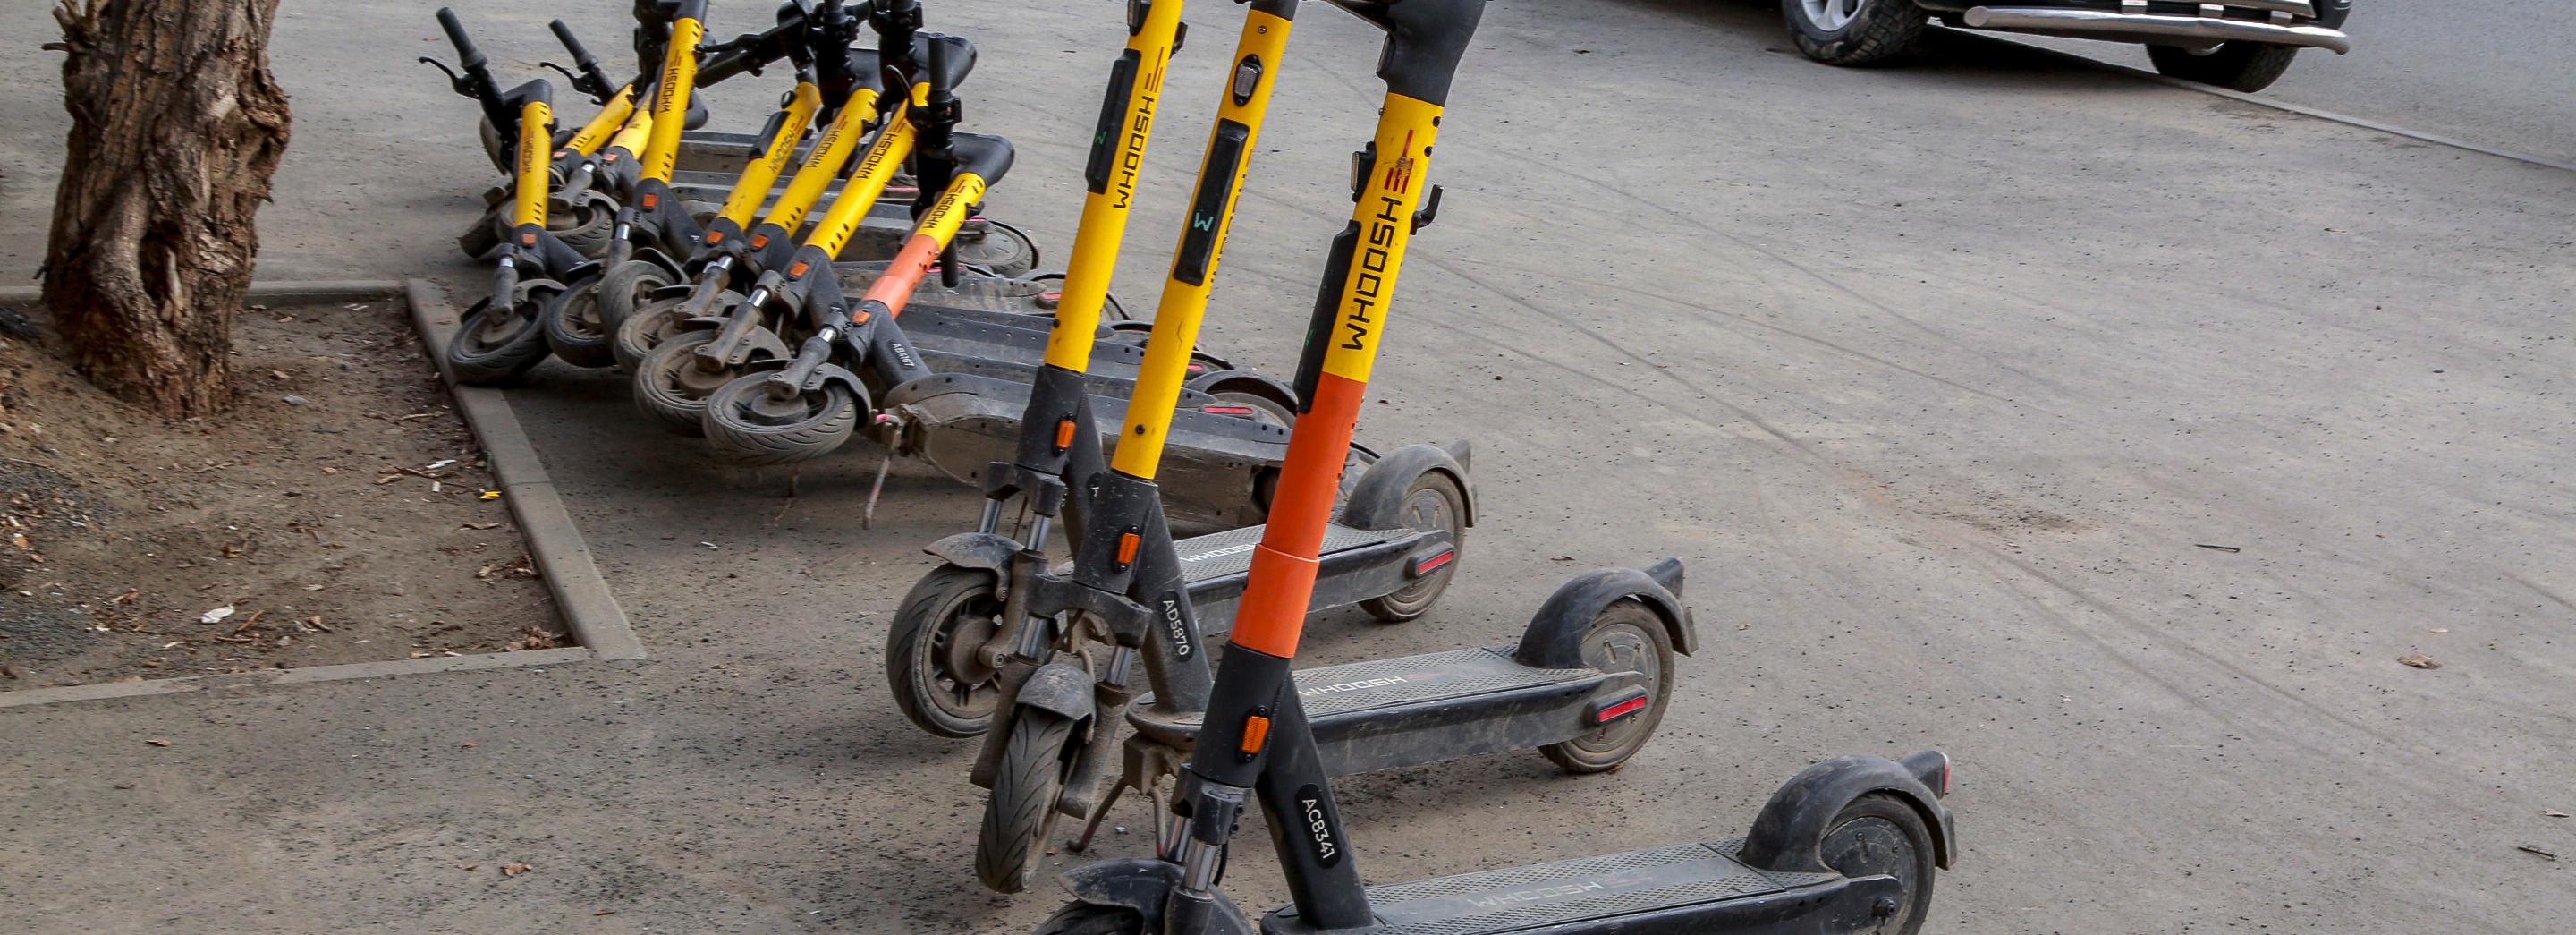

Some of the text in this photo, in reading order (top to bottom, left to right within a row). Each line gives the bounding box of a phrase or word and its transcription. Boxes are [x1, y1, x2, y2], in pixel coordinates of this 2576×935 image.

[660, 68, 679, 113] WHOOSH
[807, 129, 840, 169] WHOOSH
[857, 132, 897, 180] WHOOSH
[1113, 96, 1154, 208] WHOOSH
[923, 192, 959, 230] WHOOSH
[1342, 196, 1402, 350] WHOOSH
[1163, 600, 1190, 657] AD5870
[1298, 676, 1409, 697] WHOOSH
[1302, 798, 1335, 860] AC8341
[1467, 880, 1606, 907] WHOOSH
